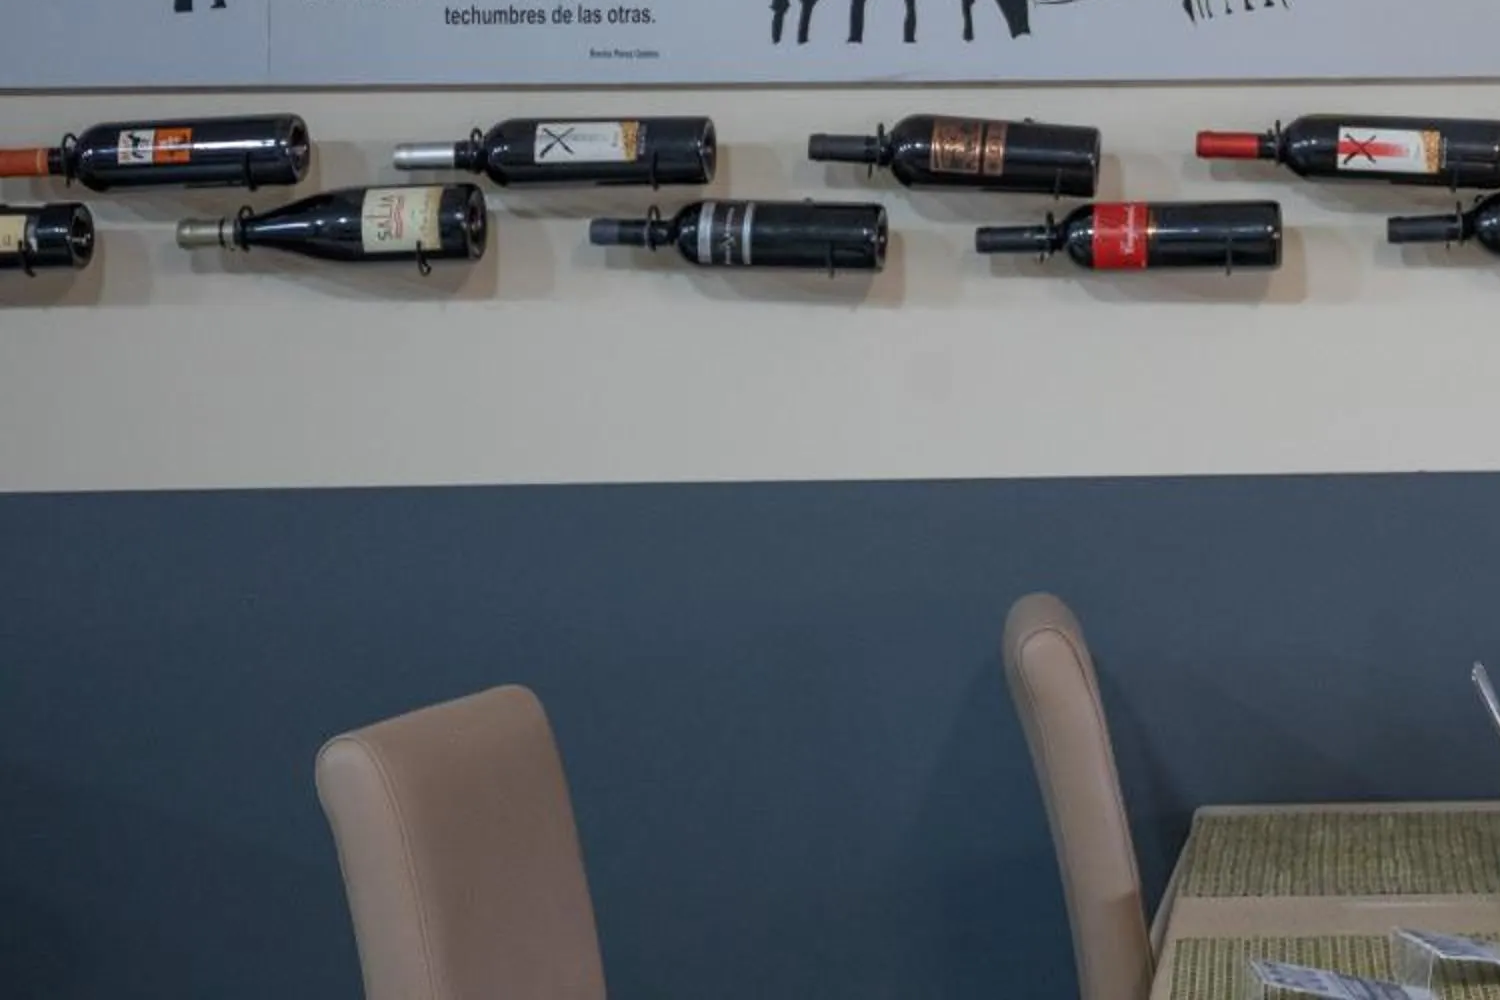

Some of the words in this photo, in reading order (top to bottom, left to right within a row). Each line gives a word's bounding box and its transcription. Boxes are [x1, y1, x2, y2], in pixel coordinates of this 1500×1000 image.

[445, 5, 546, 25] techumbres
[552, 5, 572, 24] de
[578, 5, 602, 24] las
[607, 6, 656, 24] otras.
